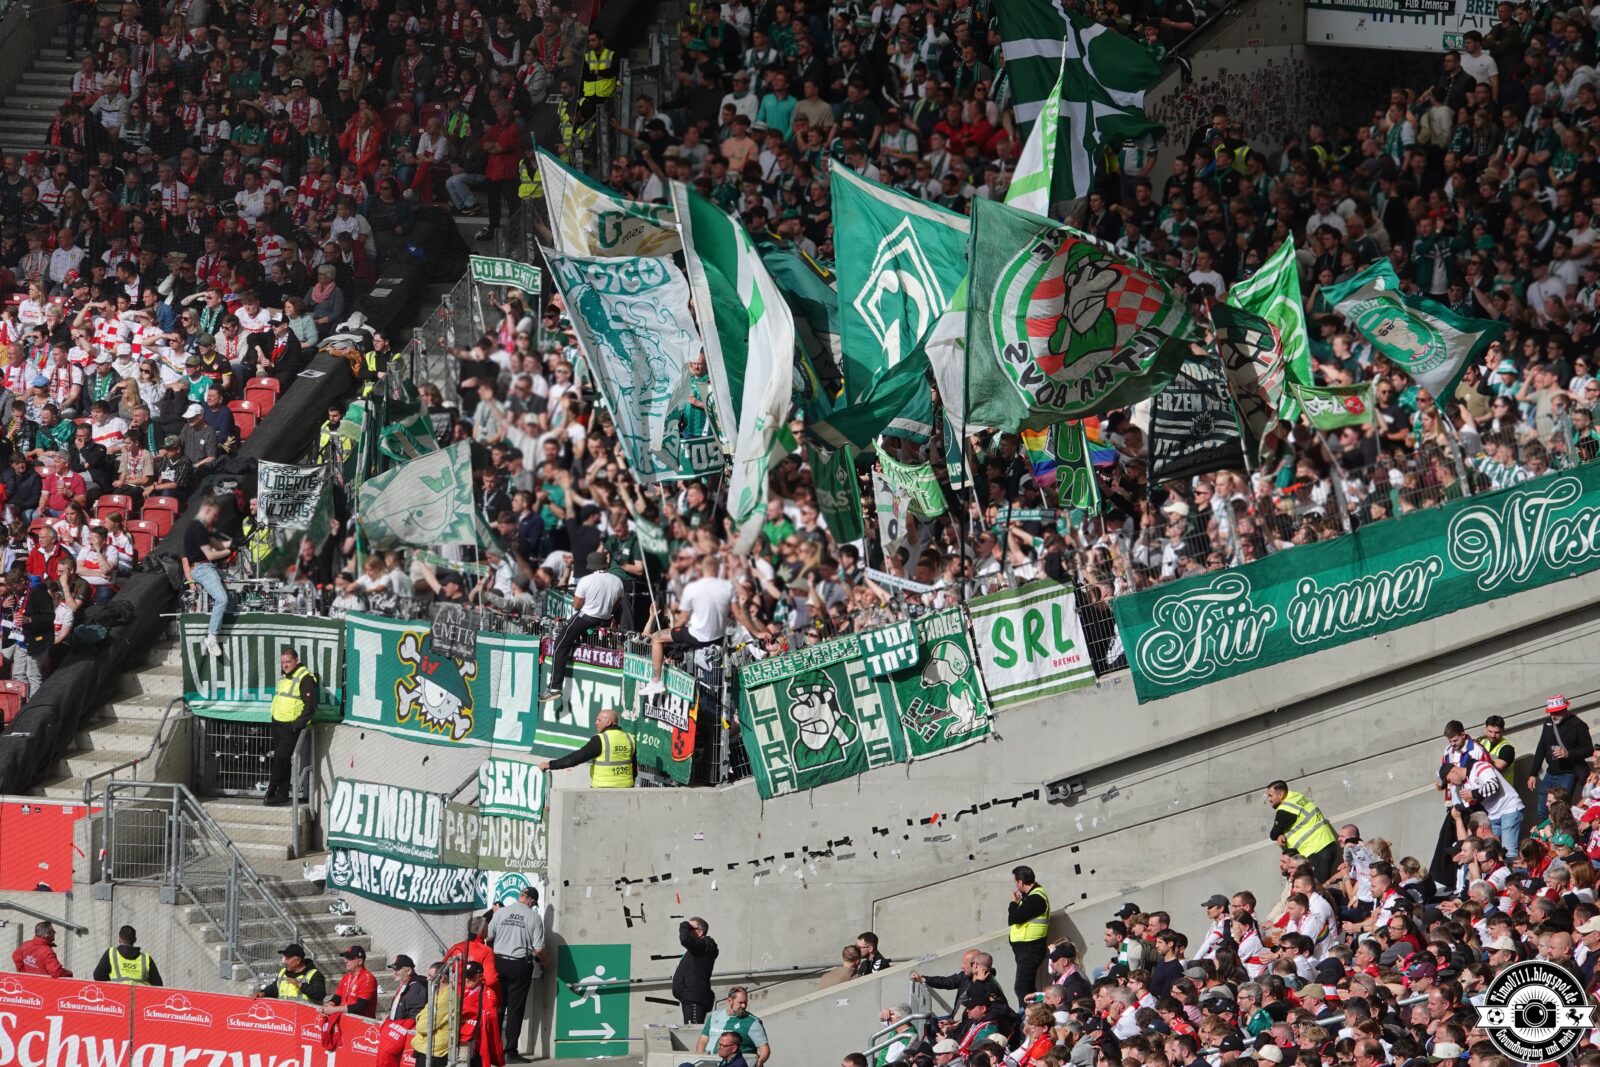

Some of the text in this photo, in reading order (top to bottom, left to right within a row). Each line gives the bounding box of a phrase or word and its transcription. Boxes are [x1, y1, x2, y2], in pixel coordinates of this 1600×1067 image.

[1420, 1, 1449, 11] IMMER
[1057, 465, 1089, 508] 20
[991, 603, 1075, 669] SRL
[1137, 573, 1276, 685] Für
[1288, 555, 1443, 645] immer
[742, 638, 859, 677] AUSGESPERRTE
[744, 664, 796, 686] NIEMALS
[1052, 655, 1081, 668] BREMEN
[479, 758, 544, 812] SEKO
[330, 780, 441, 848] DETMOLD
[445, 810, 547, 860] PAPENBURG
[350, 849, 476, 904] BREMERHAVEN
[122, 962, 137, 970] SDS
[59, 1000, 123, 1015] Schwarzwaldmilch
[145, 1010, 210, 1024] Schwarzwaldmilch
[228, 1018, 294, 1032] Schwarzwaldmilch
